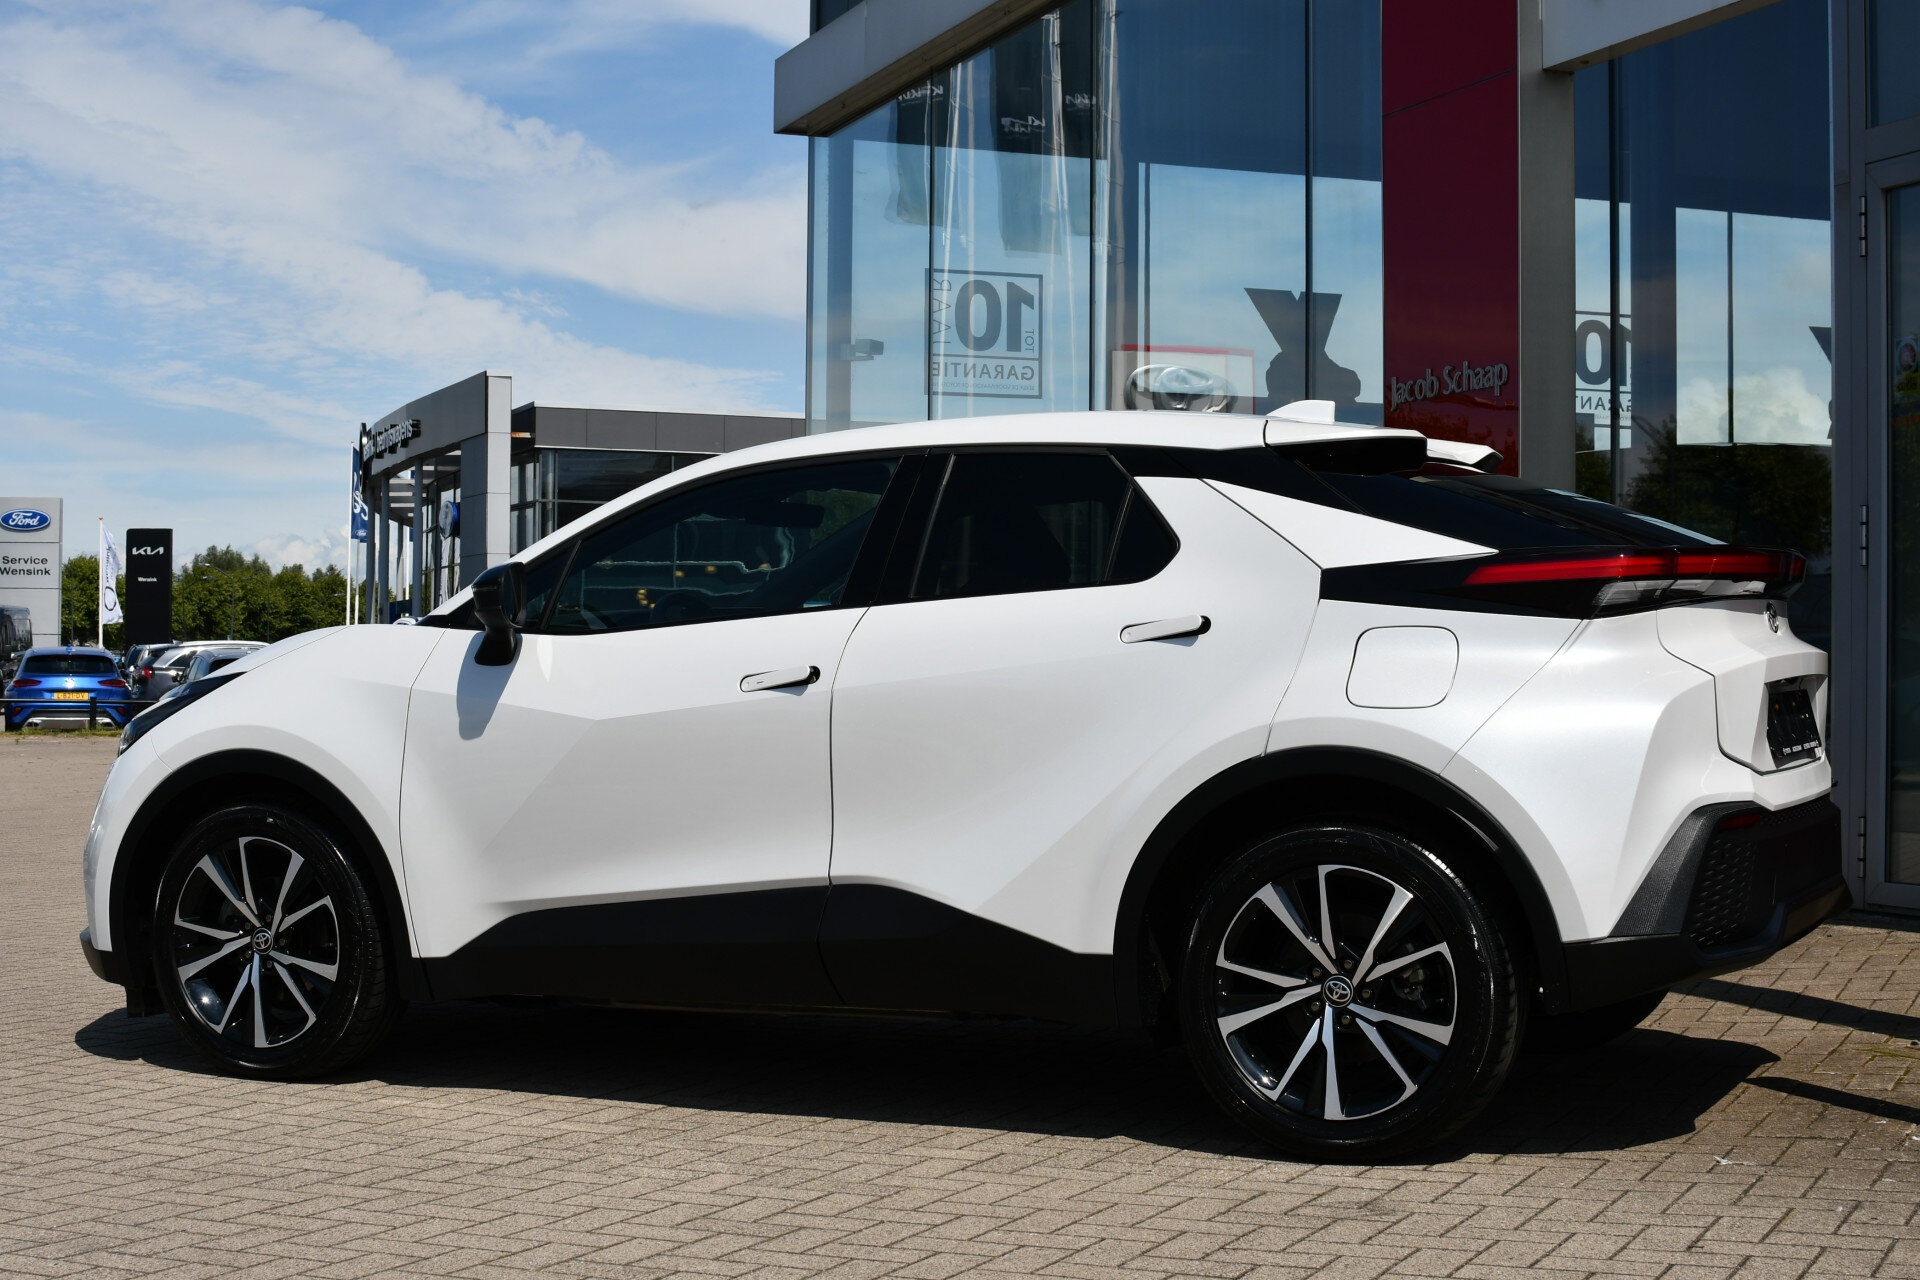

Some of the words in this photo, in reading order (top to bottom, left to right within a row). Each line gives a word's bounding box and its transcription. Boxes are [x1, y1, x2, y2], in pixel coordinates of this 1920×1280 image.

[1391, 368, 1440, 412] Jacob
[1443, 360, 1508, 397] Schaap
[9, 512, 40, 526] Ford
[132, 546, 165, 555] KIA
[2, 555, 48, 565] Service
[0, 566, 51, 576] Wensink
